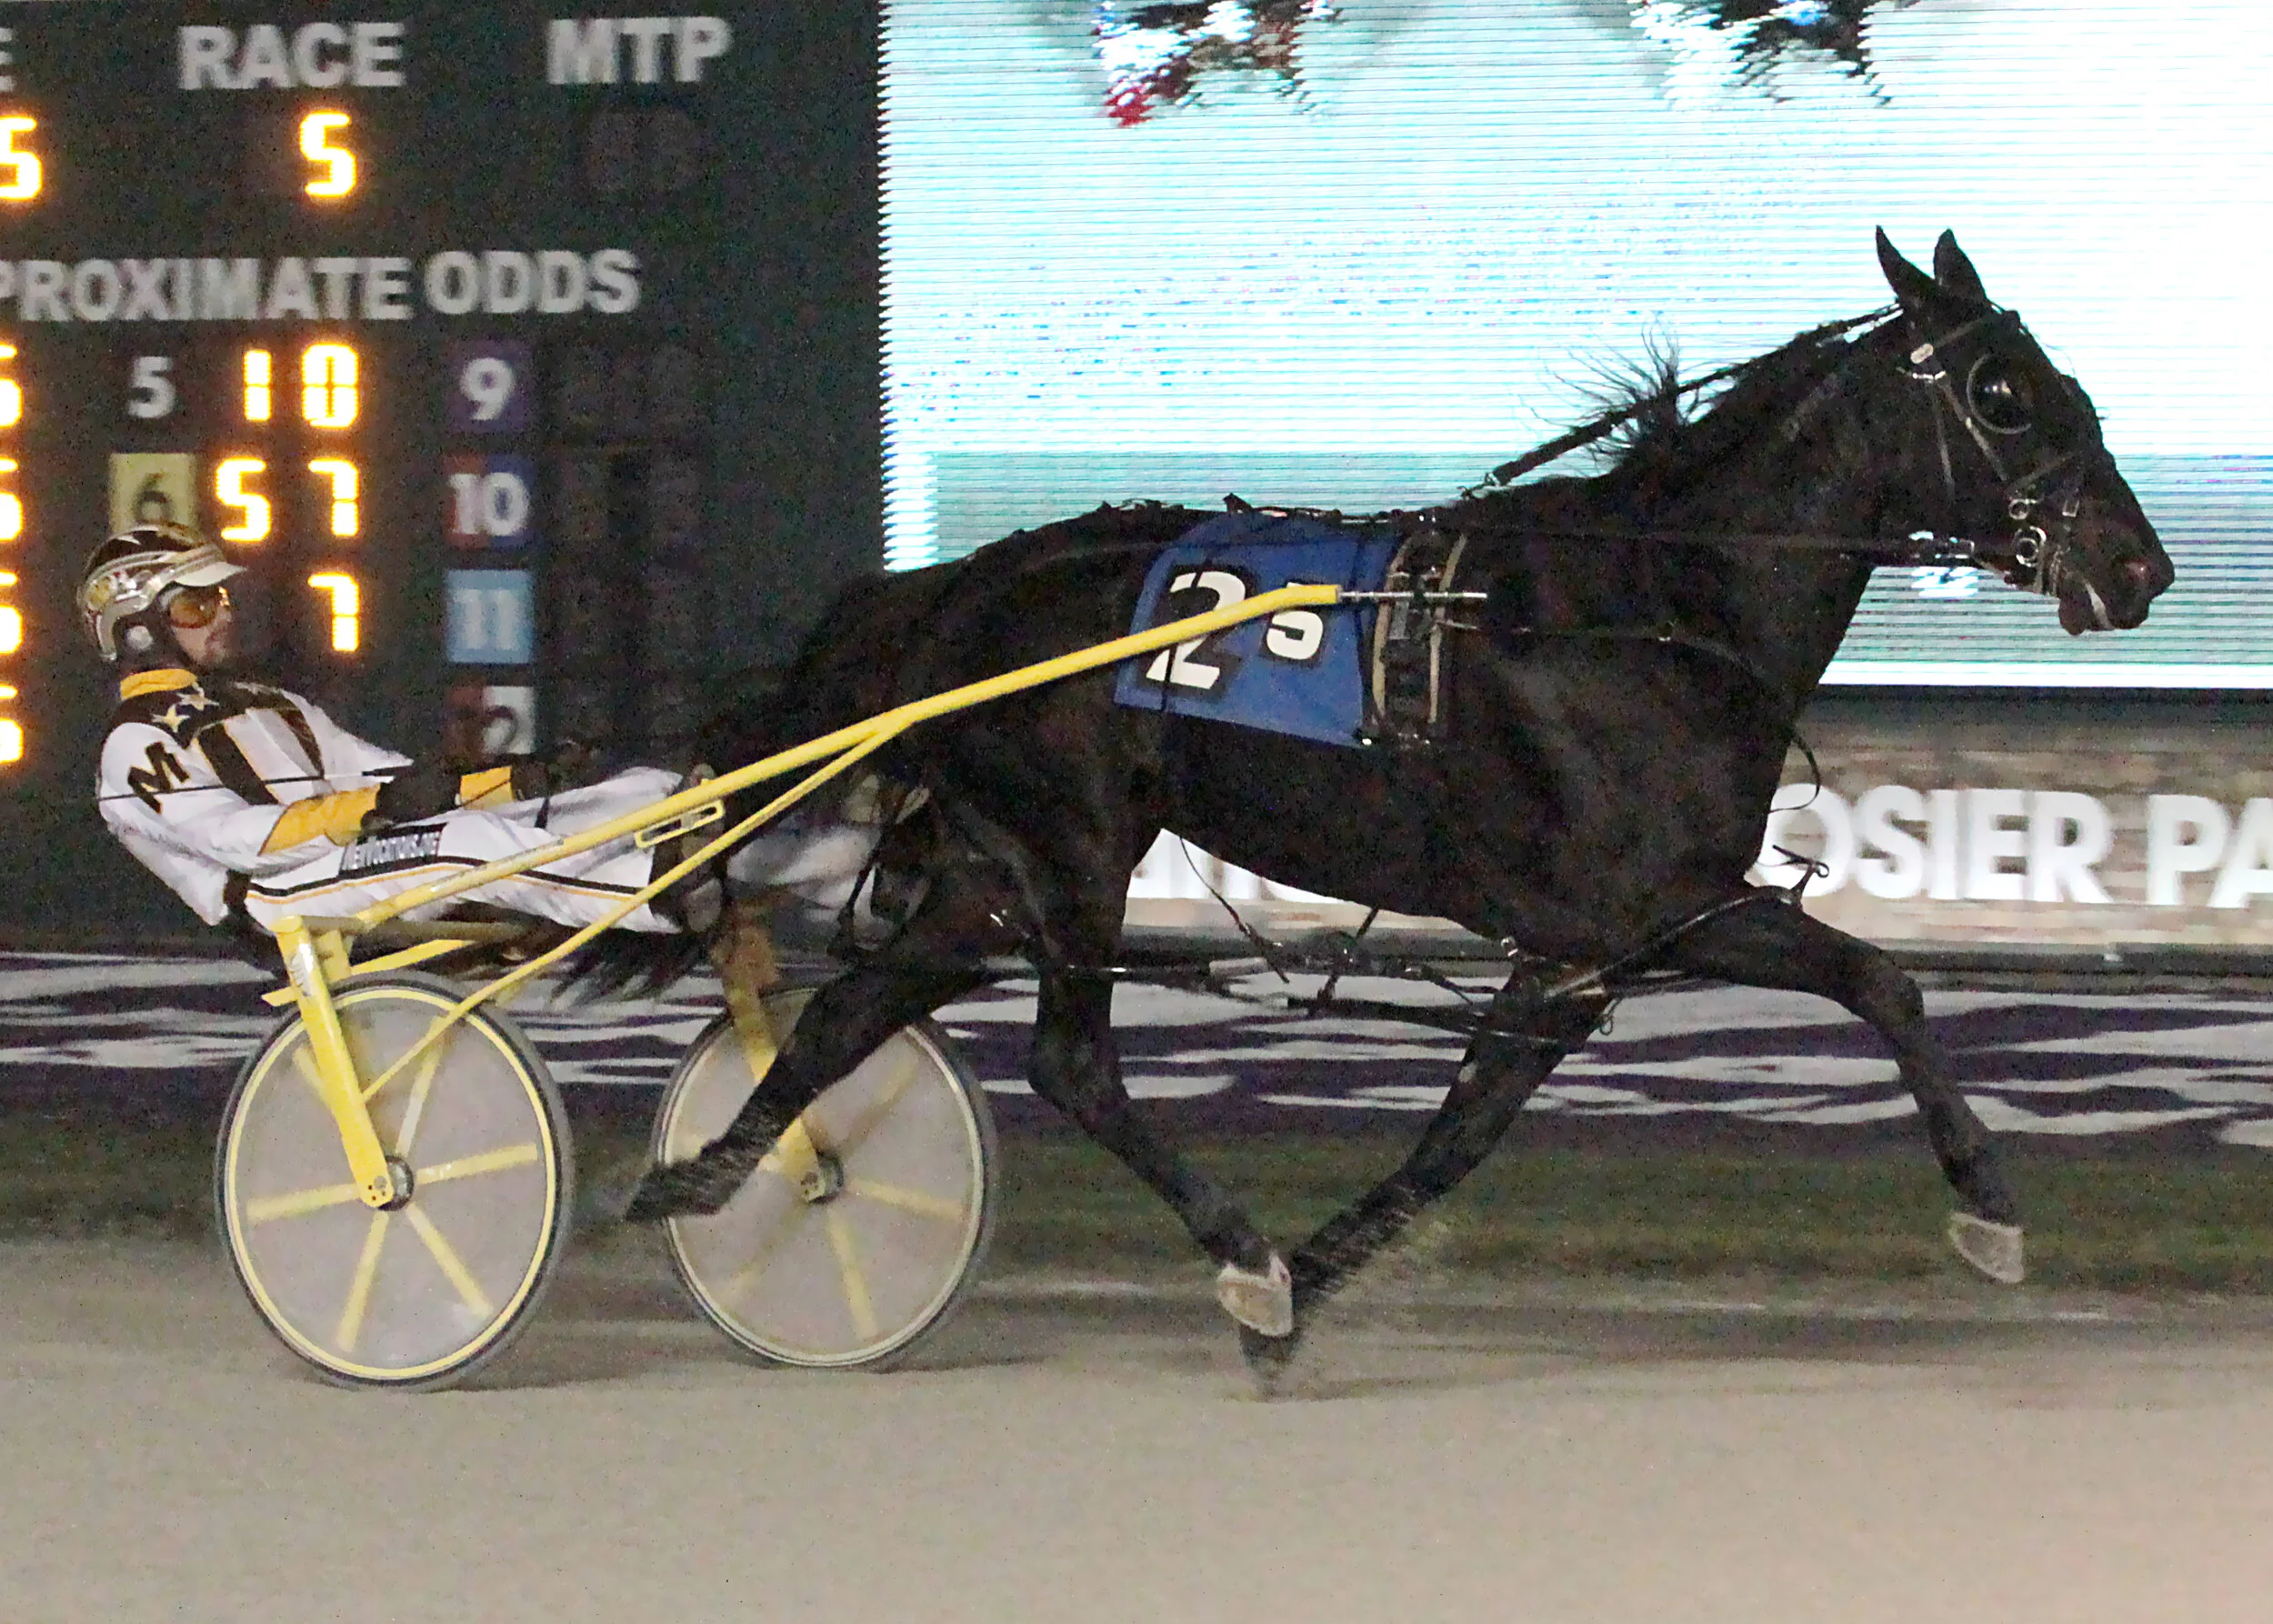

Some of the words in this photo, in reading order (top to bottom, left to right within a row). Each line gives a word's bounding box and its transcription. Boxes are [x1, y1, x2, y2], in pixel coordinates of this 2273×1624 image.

[179, 22, 406, 90] RACE
[547, 16, 730, 85] MTP
[0, 114, 43, 201] 5
[299, 111, 358, 199] 5
[426, 249, 641, 316] ODDS
[127, 356, 176, 419] 5
[243, 343, 361, 428] 10
[460, 356, 516, 421] 9
[134, 471, 175, 527] 6
[449, 470, 530, 536] 10
[306, 571, 360, 652] 7
[453, 588, 519, 650] 11
[1146, 570, 1246, 690] 2
[1267, 582, 1324, 660] 5
[126, 741, 192, 814] M
